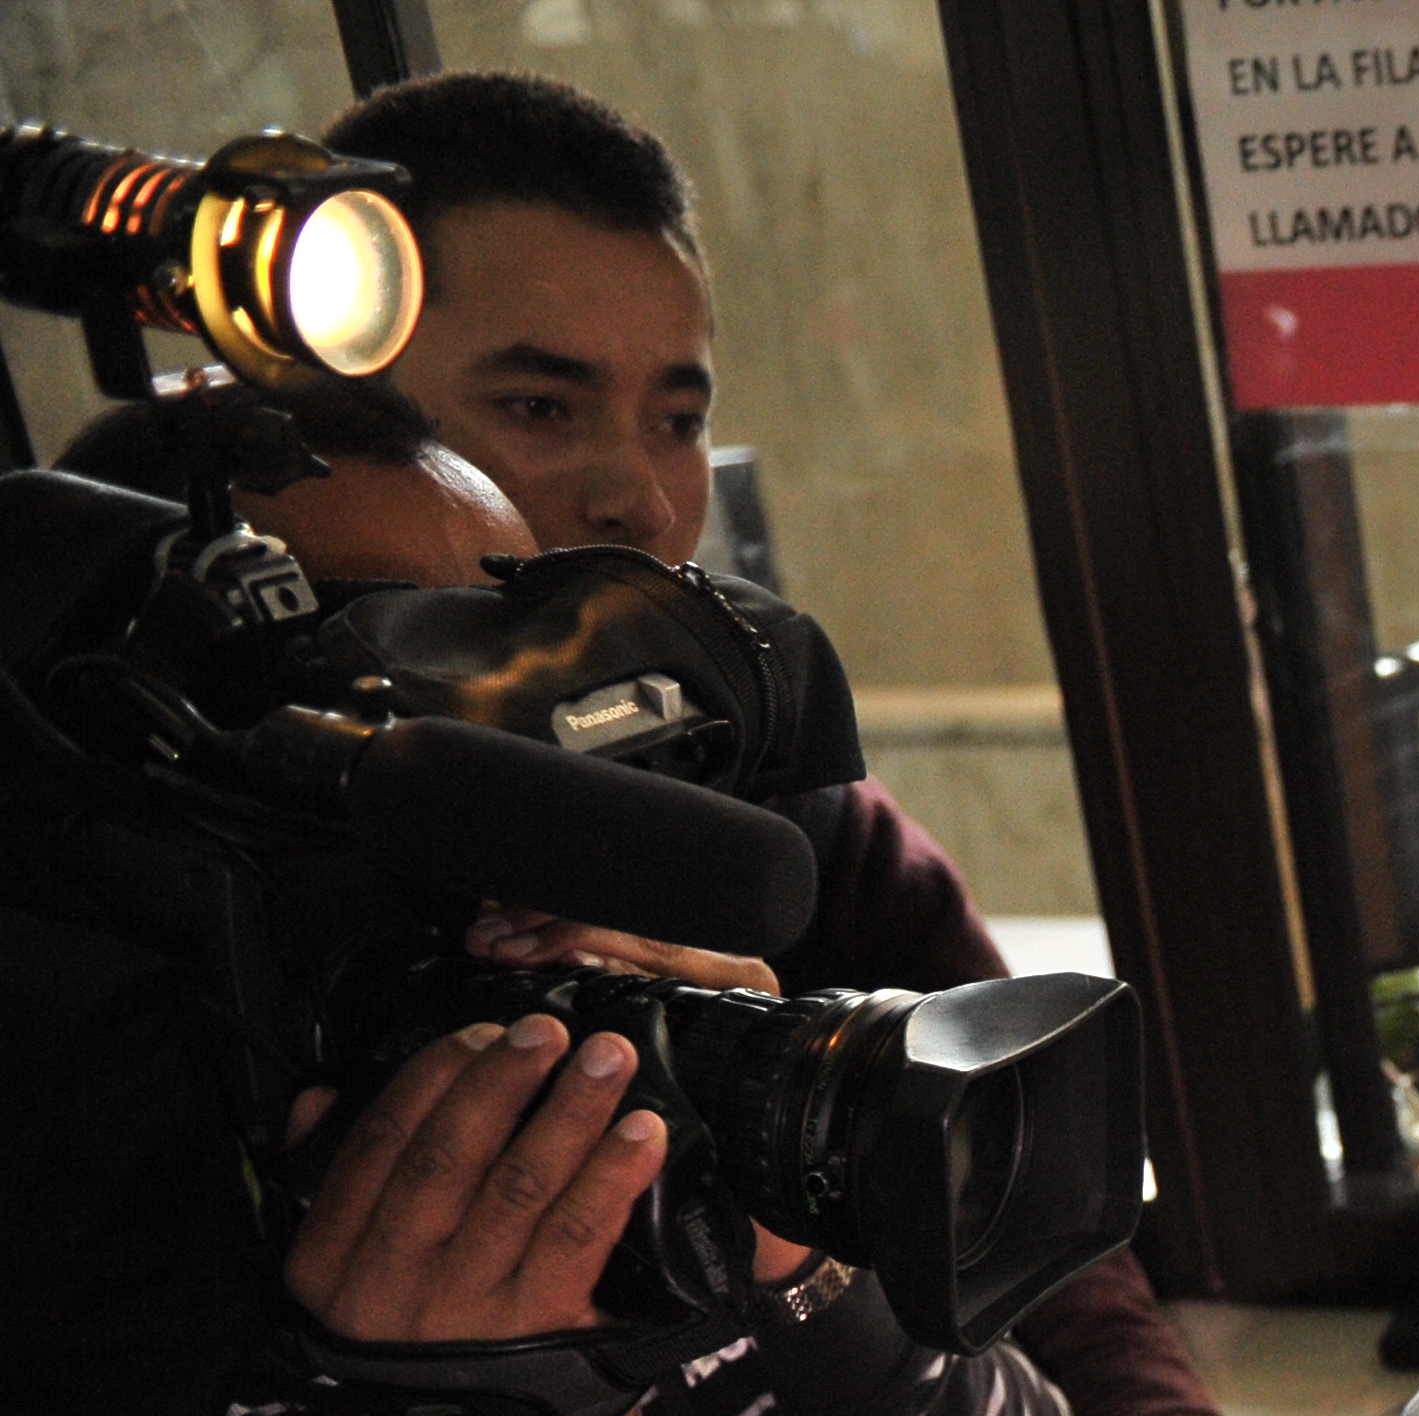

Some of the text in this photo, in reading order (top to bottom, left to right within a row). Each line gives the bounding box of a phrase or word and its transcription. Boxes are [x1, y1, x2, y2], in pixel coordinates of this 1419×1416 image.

[1228, 56, 1280, 96] EN
[1291, 53, 1343, 92] LA
[1238, 126, 1380, 174] ESPERE
[1391, 124, 1419, 162] A
[565, 699, 640, 731] Panasonic
